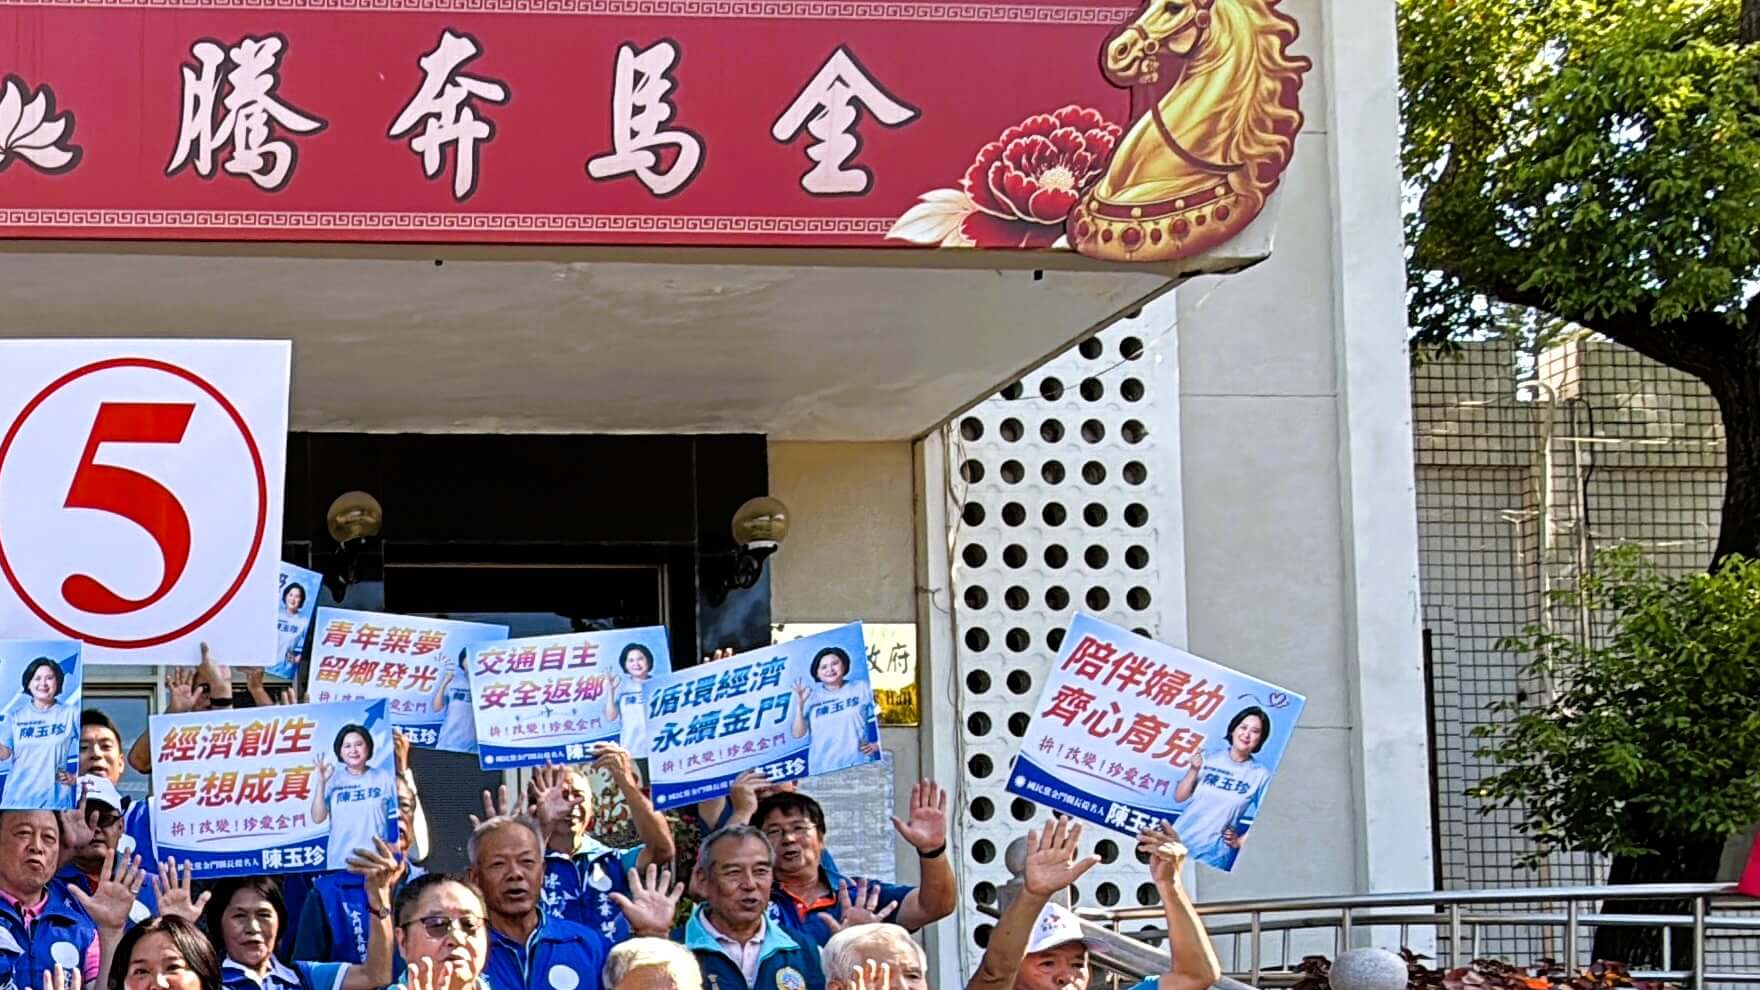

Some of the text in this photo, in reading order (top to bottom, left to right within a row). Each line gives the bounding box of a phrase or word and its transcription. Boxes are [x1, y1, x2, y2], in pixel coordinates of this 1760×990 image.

[61, 402, 196, 615] 5
[321, 620, 447, 656] 青年築夢
[474, 640, 599, 676] 交通自主
[316, 655, 438, 692] 留鄉發光
[479, 675, 606, 710] 安全返鄉
[649, 656, 787, 718] 循環經濟
[1061, 636, 1225, 722] 陪伴婦幼
[158, 719, 316, 763] 經濟創生
[652, 692, 792, 752] 永續金門
[1042, 684, 1205, 768] 齊心育兒
[160, 765, 316, 811] 夢想成真
[755, 758, 806, 782] 玉珍
[262, 845, 326, 869] 陳玉珍
